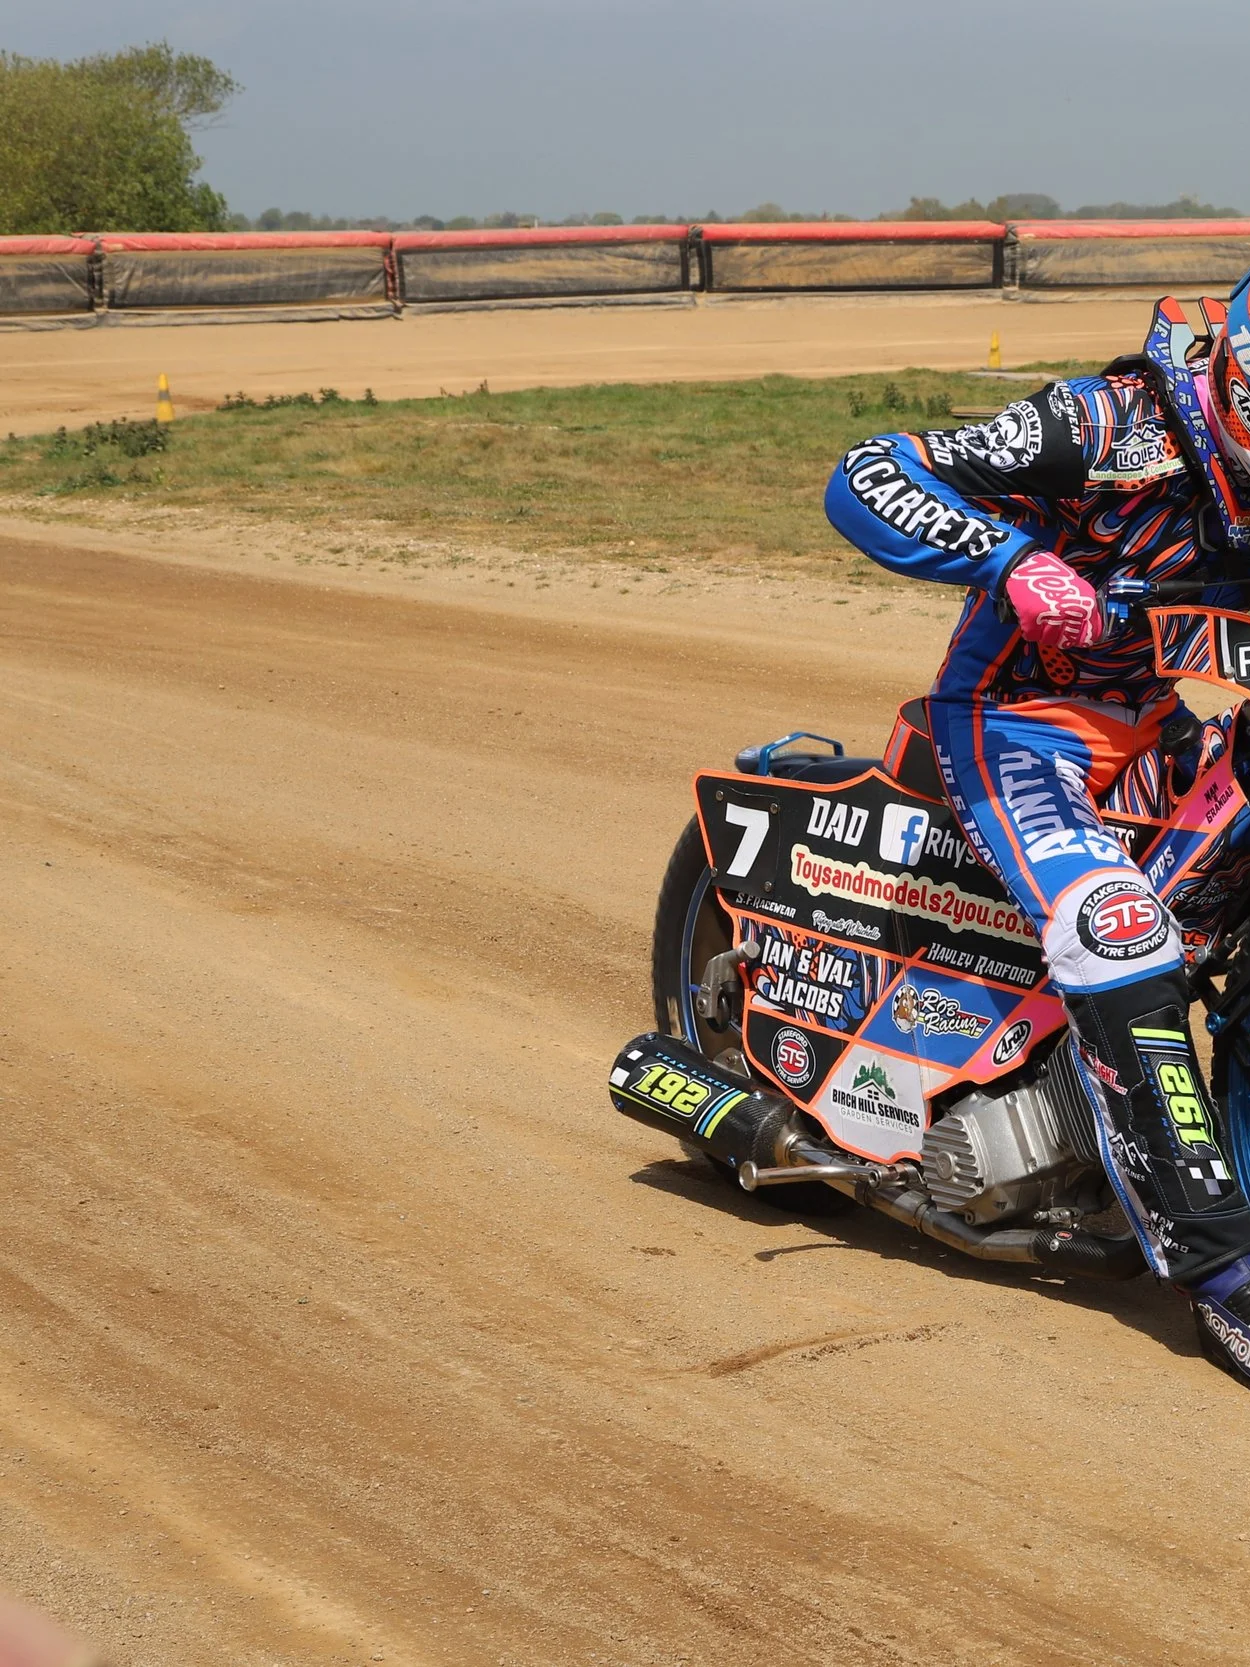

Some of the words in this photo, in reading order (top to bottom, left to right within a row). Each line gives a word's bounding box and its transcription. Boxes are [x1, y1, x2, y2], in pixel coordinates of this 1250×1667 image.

[852, 460, 1004, 557] CARPETS
[806, 796, 870, 847] DAD
[998, 750, 1087, 864] AUNTY
[725, 802, 770, 878] 7
[1146, 845, 1176, 887] PPS
[1082, 882, 1148, 916] STAKEFORD
[1094, 899, 1156, 938] STS
[1096, 944, 1125, 957] TYRE
[1127, 924, 1168, 956] SERVICES
[761, 934, 795, 970] IAN
[797, 949, 813, 974] &
[816, 951, 854, 988] VAL
[926, 942, 975, 968] HAYLEY
[974, 955, 1036, 985] RADFORD
[768, 972, 844, 1018] JACOBS
[778, 1030, 808, 1048] STAKEFORD
[924, 1012, 979, 1036] Racing
[997, 1022, 1029, 1061] Arai
[655, 1051, 688, 1069] TEAM
[778, 1045, 807, 1067] STS
[631, 1063, 711, 1117] 192
[786, 1072, 810, 1085] SERVICES
[832, 1088, 858, 1109] BIRCH
[858, 1097, 877, 1115] HILL
[878, 1103, 920, 1128] SERVICES
[840, 1106, 872, 1123] GARDEN
[875, 1118, 913, 1134] SERVICES
[1157, 1062, 1214, 1150] 192
